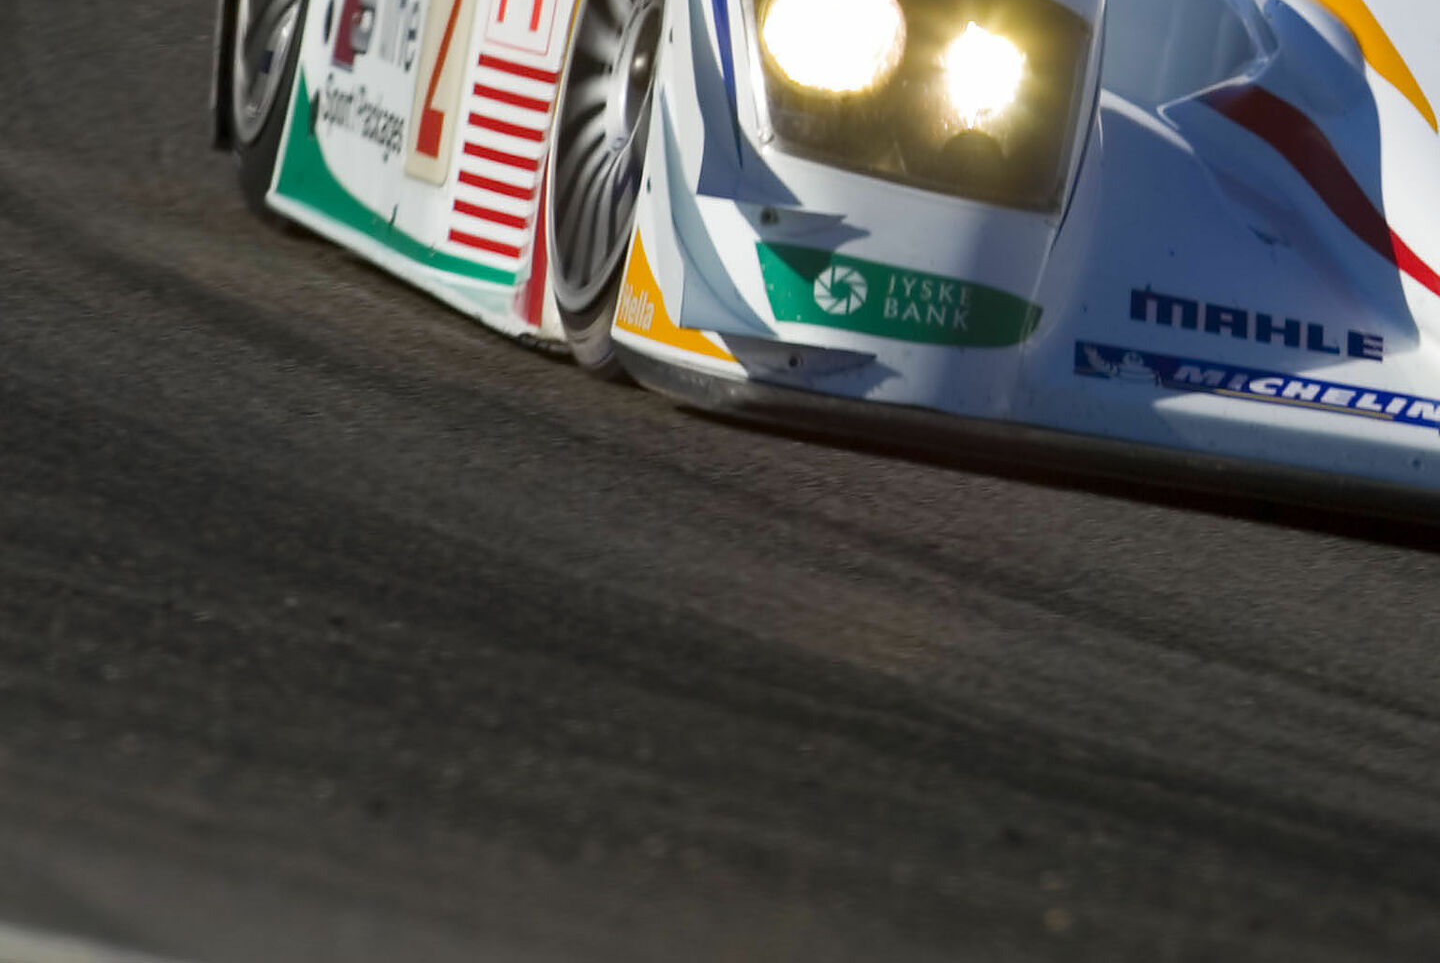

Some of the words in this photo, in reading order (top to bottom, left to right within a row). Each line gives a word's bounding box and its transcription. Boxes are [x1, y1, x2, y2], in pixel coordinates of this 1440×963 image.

[619, 281, 655, 332] Hella
[885, 272, 972, 307] JYSKE
[883, 297, 970, 331] BANK
[1130, 287, 1384, 363] MAHLE
